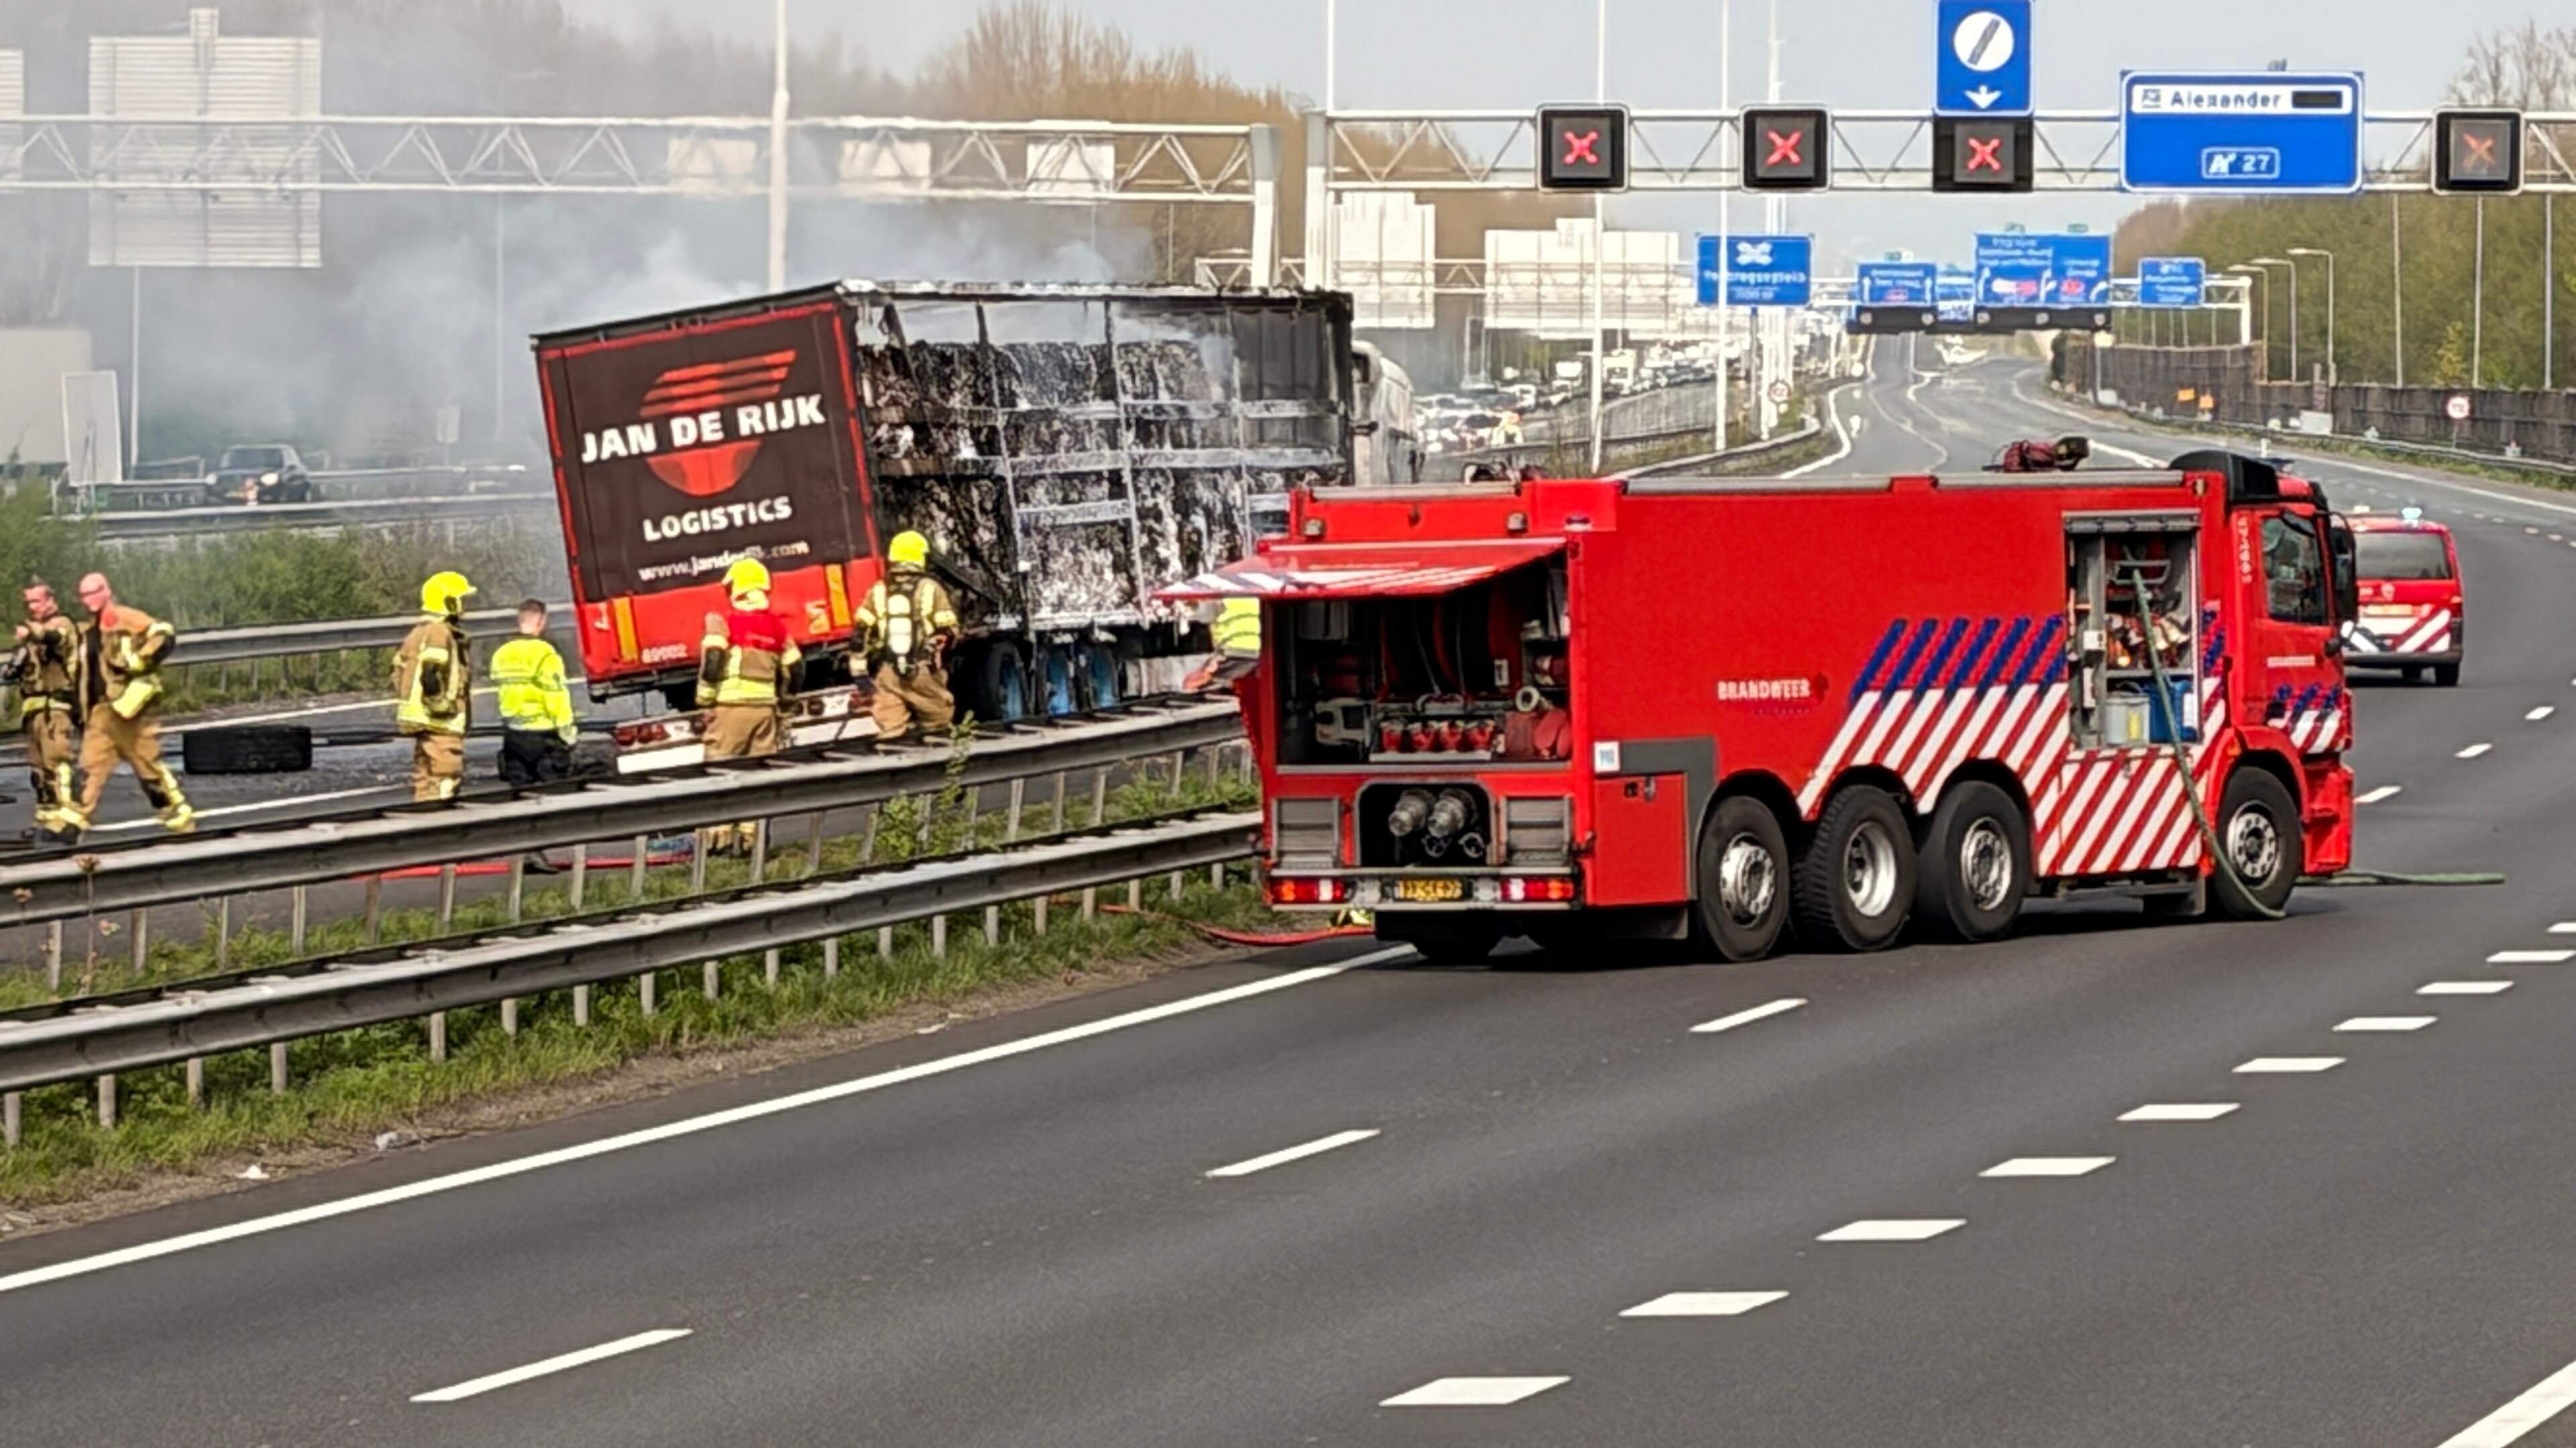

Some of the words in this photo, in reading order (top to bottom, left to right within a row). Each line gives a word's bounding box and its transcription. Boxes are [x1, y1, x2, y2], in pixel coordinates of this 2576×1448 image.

[2170, 89, 2282, 109] Alexander
[2241, 154, 2270, 172] 27
[581, 422, 657, 463] JAN
[670, 410, 724, 448] DE
[736, 393, 826, 437] RIJK
[642, 495, 794, 542] LOGISTICS
[1717, 677, 1811, 700] BRANDWEER
